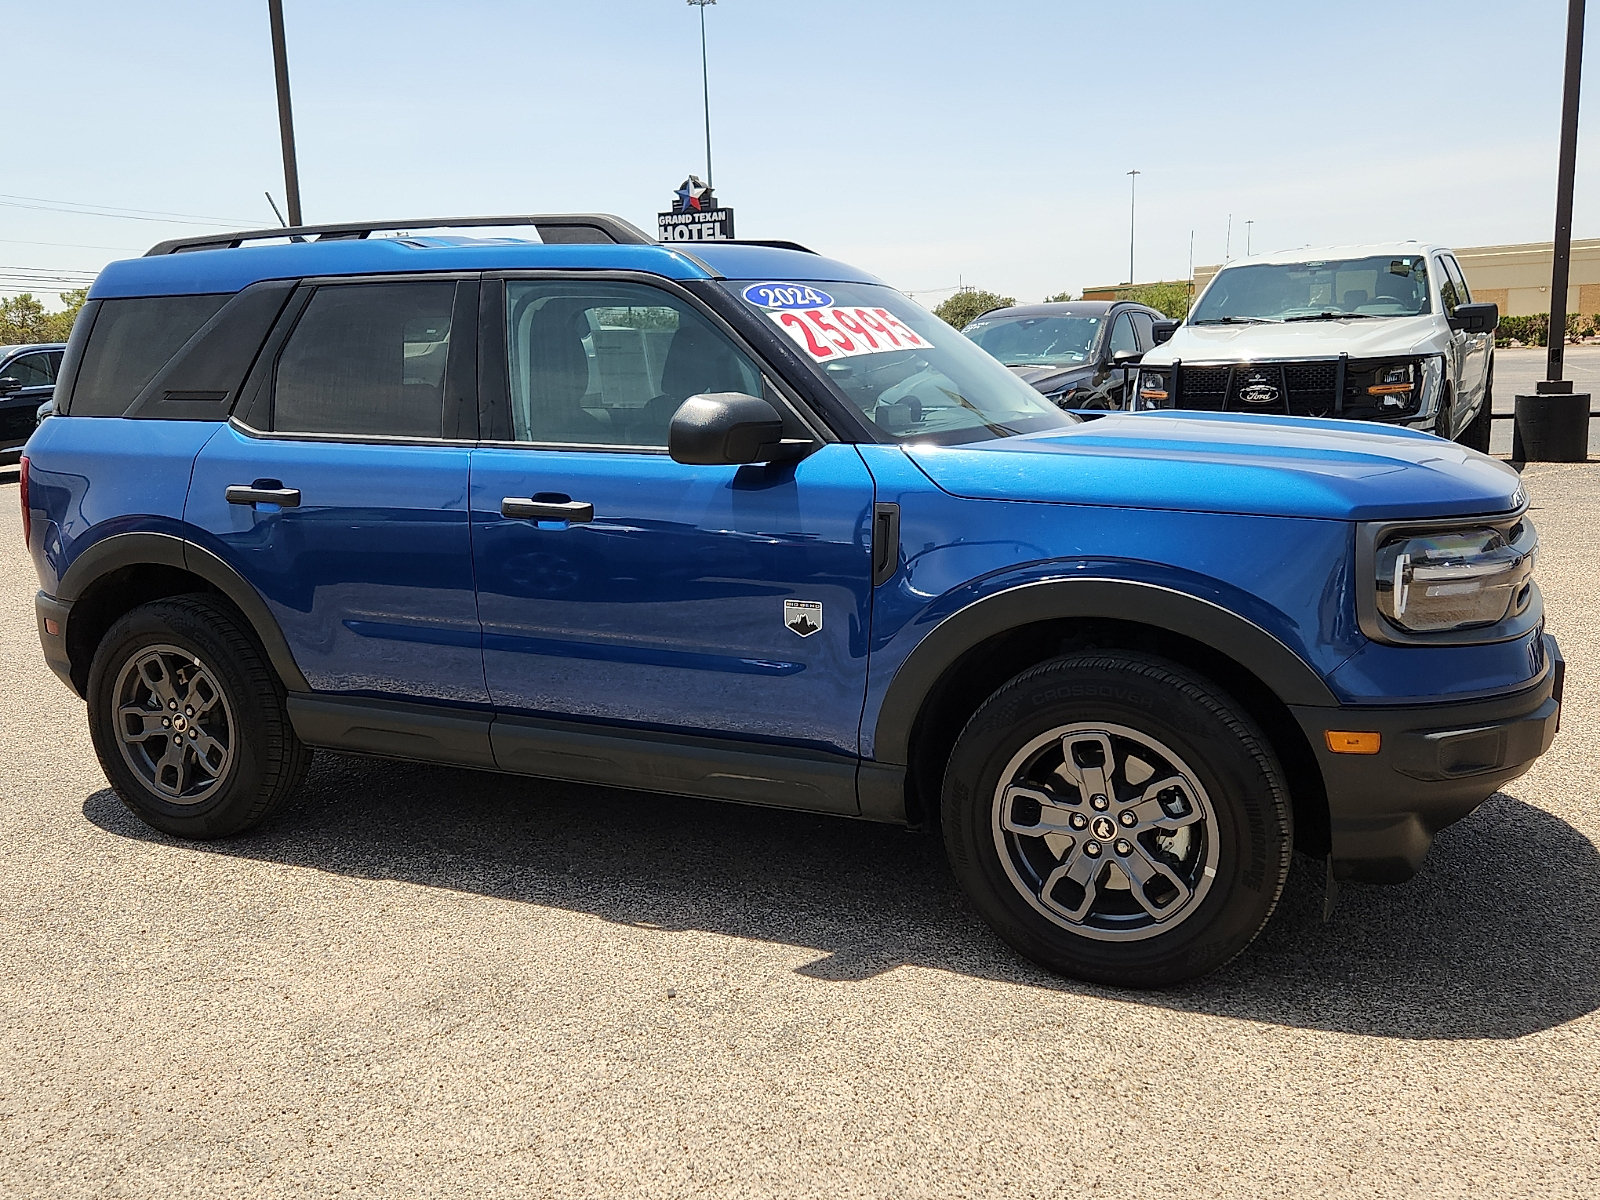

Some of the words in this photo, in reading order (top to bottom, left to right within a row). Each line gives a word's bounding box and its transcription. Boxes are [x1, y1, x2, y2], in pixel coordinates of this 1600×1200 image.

[659, 214, 692, 225] GRAND
[693, 211, 726, 222] TEXAN
[659, 222, 726, 240] HOTEL
[760, 287, 823, 307] 2024
[780, 308, 921, 357] 25995
[1031, 685, 1153, 708] CROSSOVER
